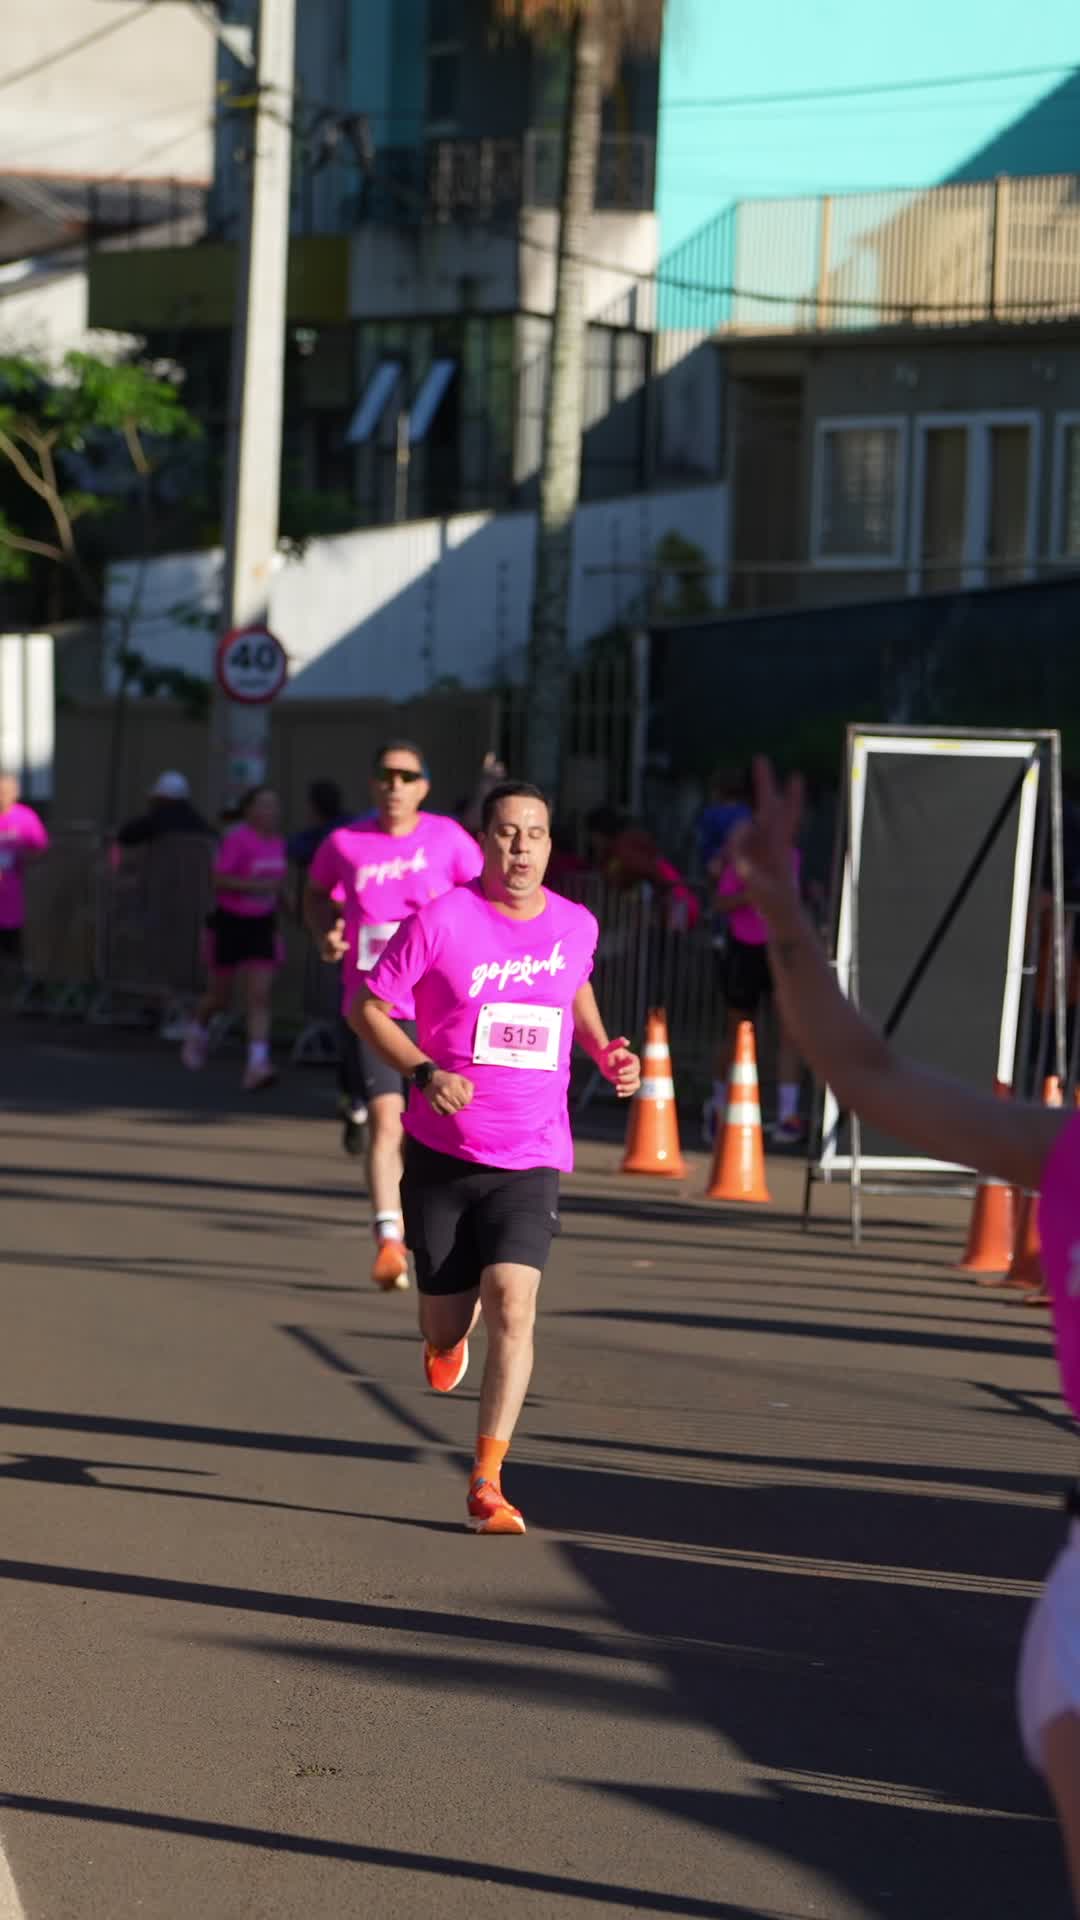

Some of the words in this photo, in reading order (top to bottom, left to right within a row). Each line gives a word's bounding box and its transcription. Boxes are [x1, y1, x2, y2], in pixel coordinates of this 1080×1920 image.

[230, 643, 278, 672] 40
[468, 940, 567, 998] gopink
[503, 1026, 537, 1045] 515
